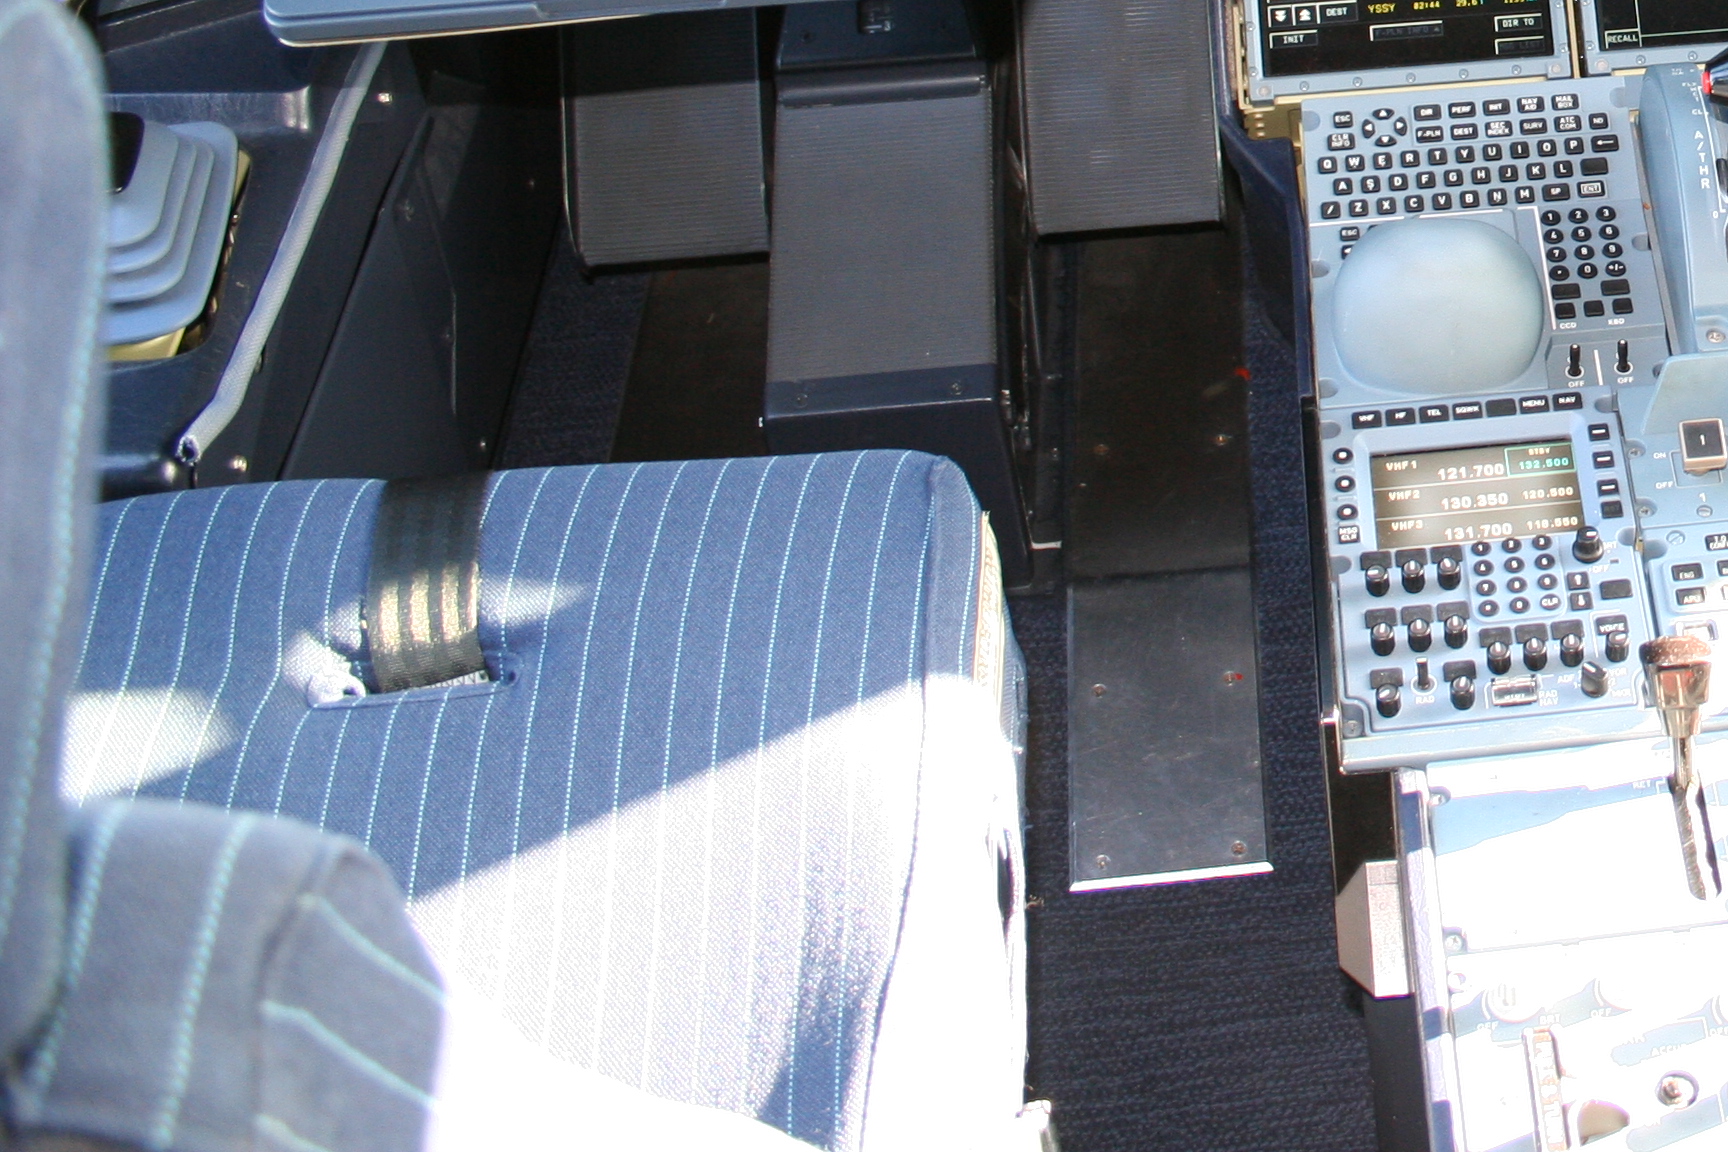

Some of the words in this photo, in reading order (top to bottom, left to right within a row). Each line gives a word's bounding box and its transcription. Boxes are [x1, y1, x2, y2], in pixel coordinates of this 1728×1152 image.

[1607, 34, 1638, 44] RECALL
[1437, 463, 1504, 481] 121.700
[1388, 489, 1420, 501] VHF2
[1441, 494, 1509, 511] 130.350
[1391, 520, 1423, 532] VHF3
[1445, 522, 1513, 541] 131.700
